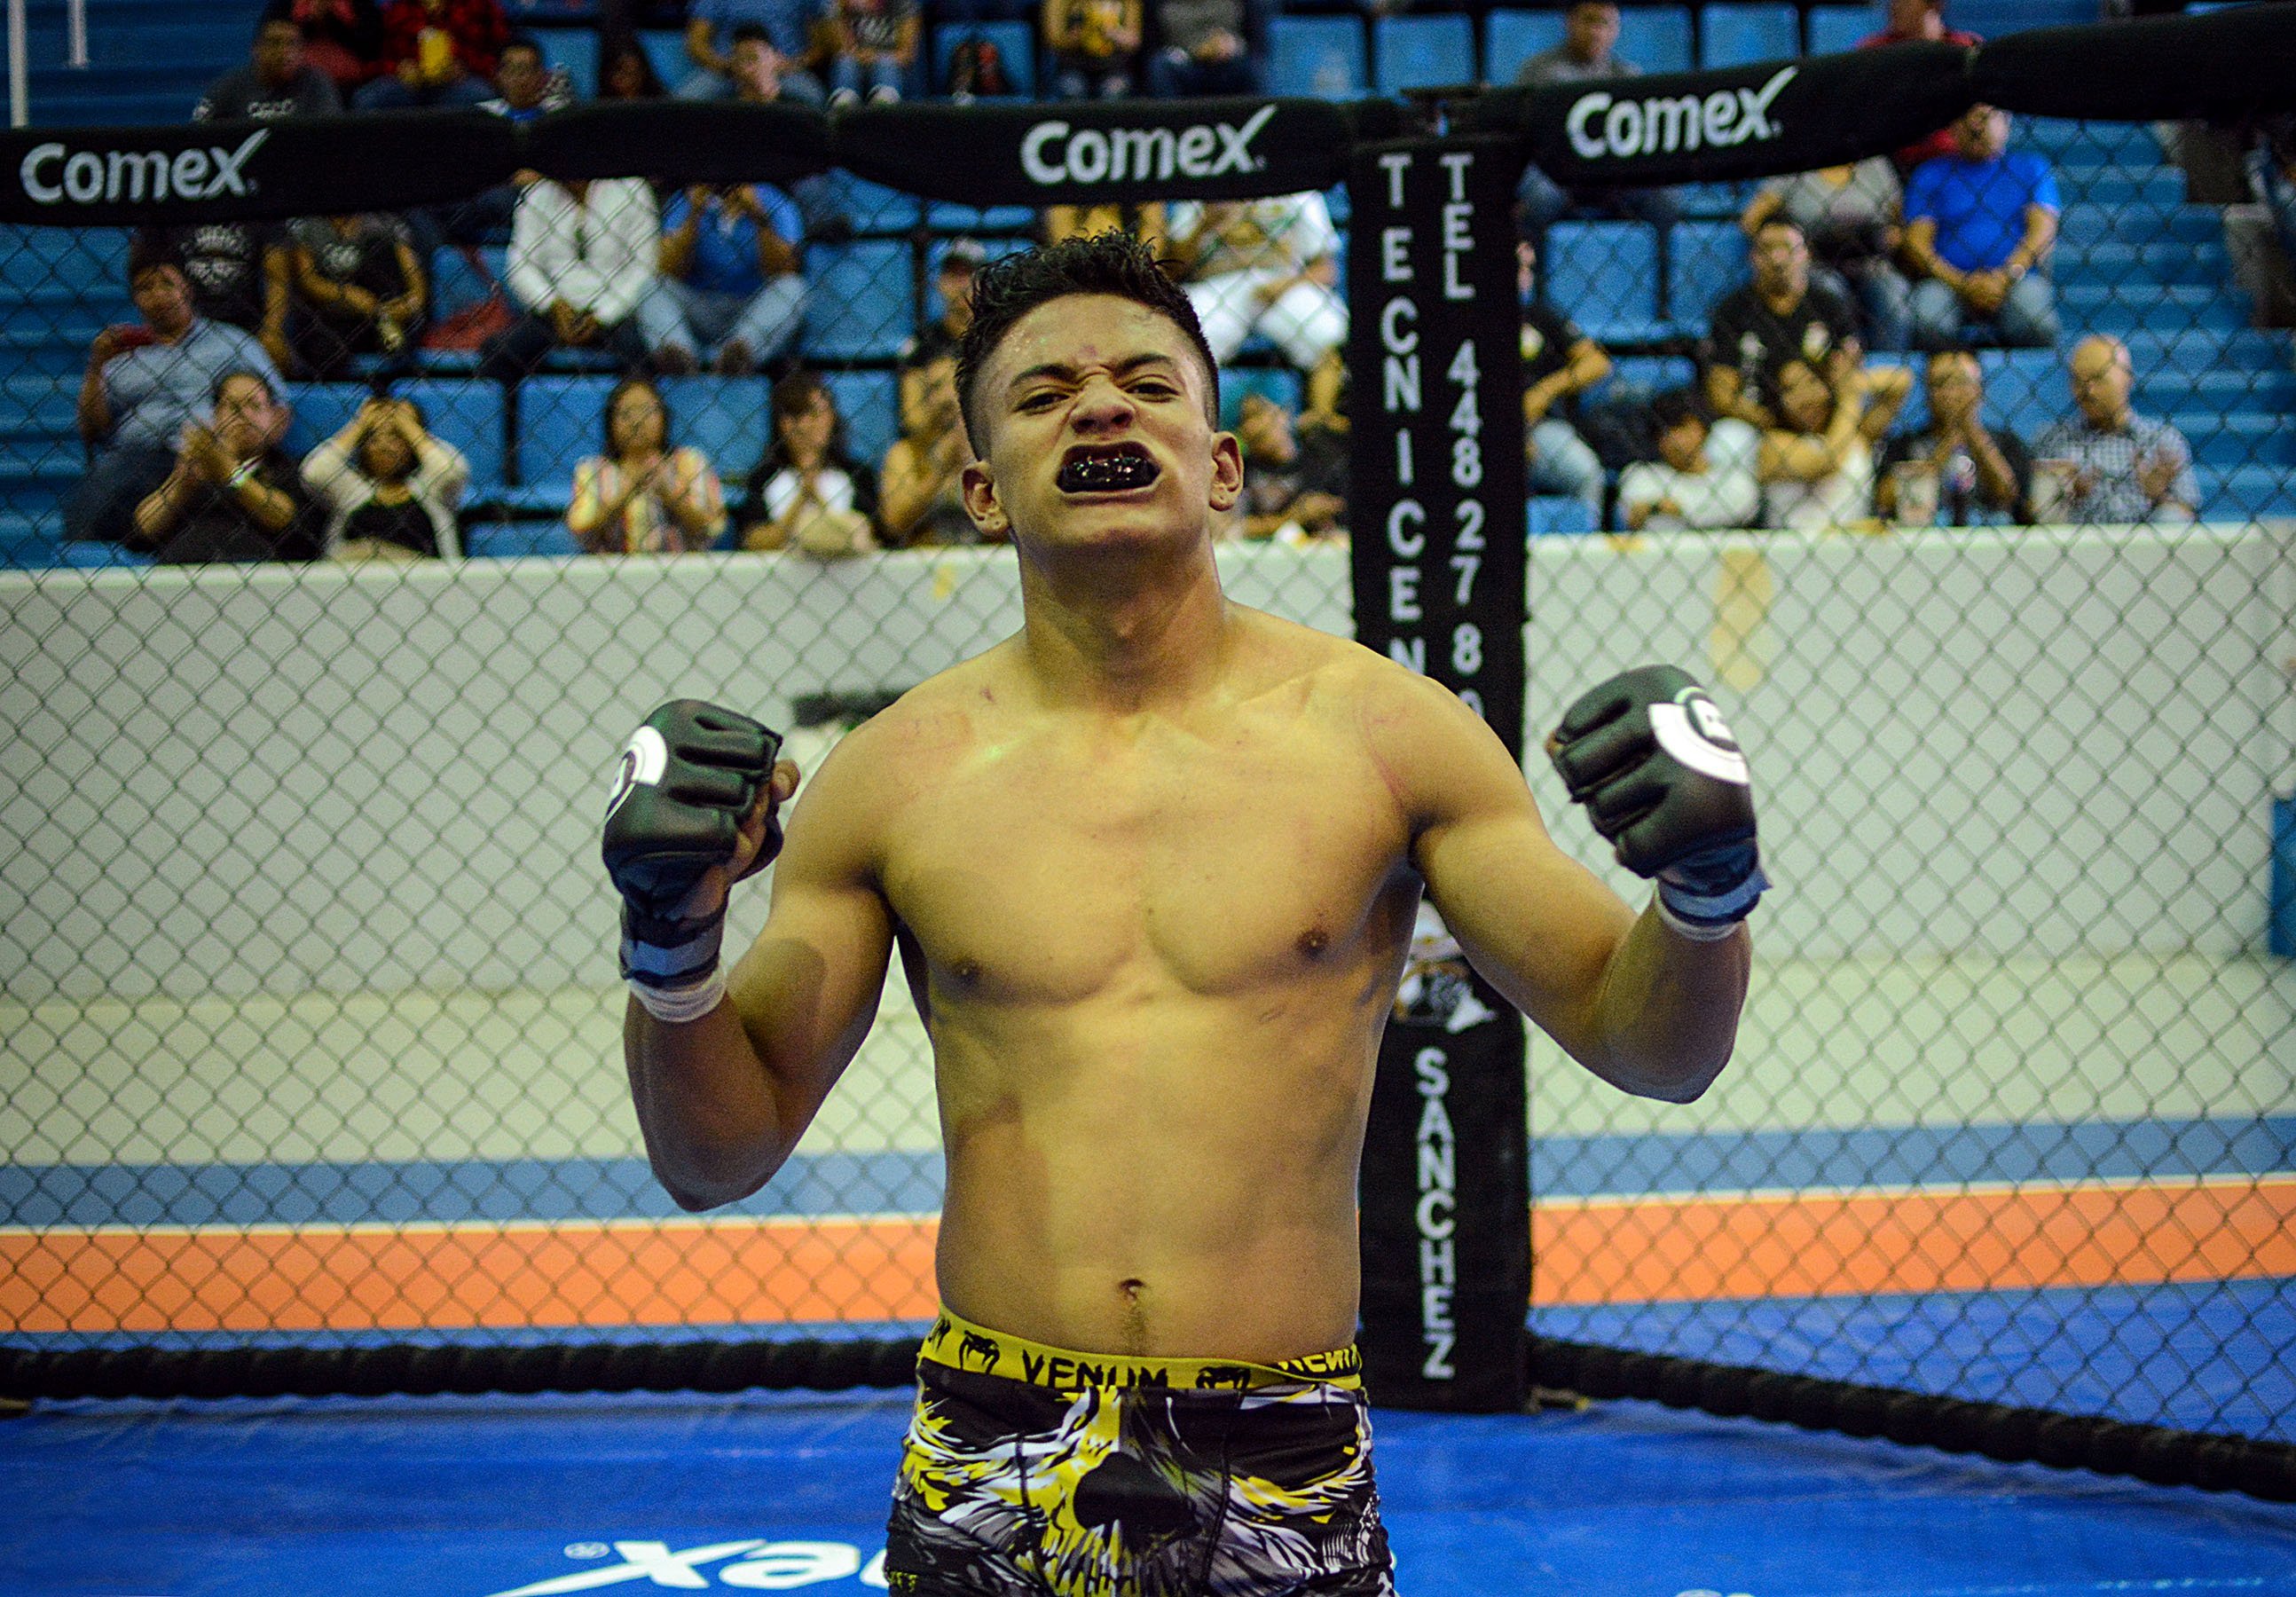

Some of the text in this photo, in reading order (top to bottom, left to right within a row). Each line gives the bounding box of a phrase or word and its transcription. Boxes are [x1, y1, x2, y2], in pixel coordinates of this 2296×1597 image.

[1021, 103, 1278, 185] Comex
[1566, 66, 1798, 158] Comex
[20, 128, 271, 204] Comex
[1441, 153, 1476, 299] TEL
[1417, 1048, 1456, 1380] SANCHEZ
